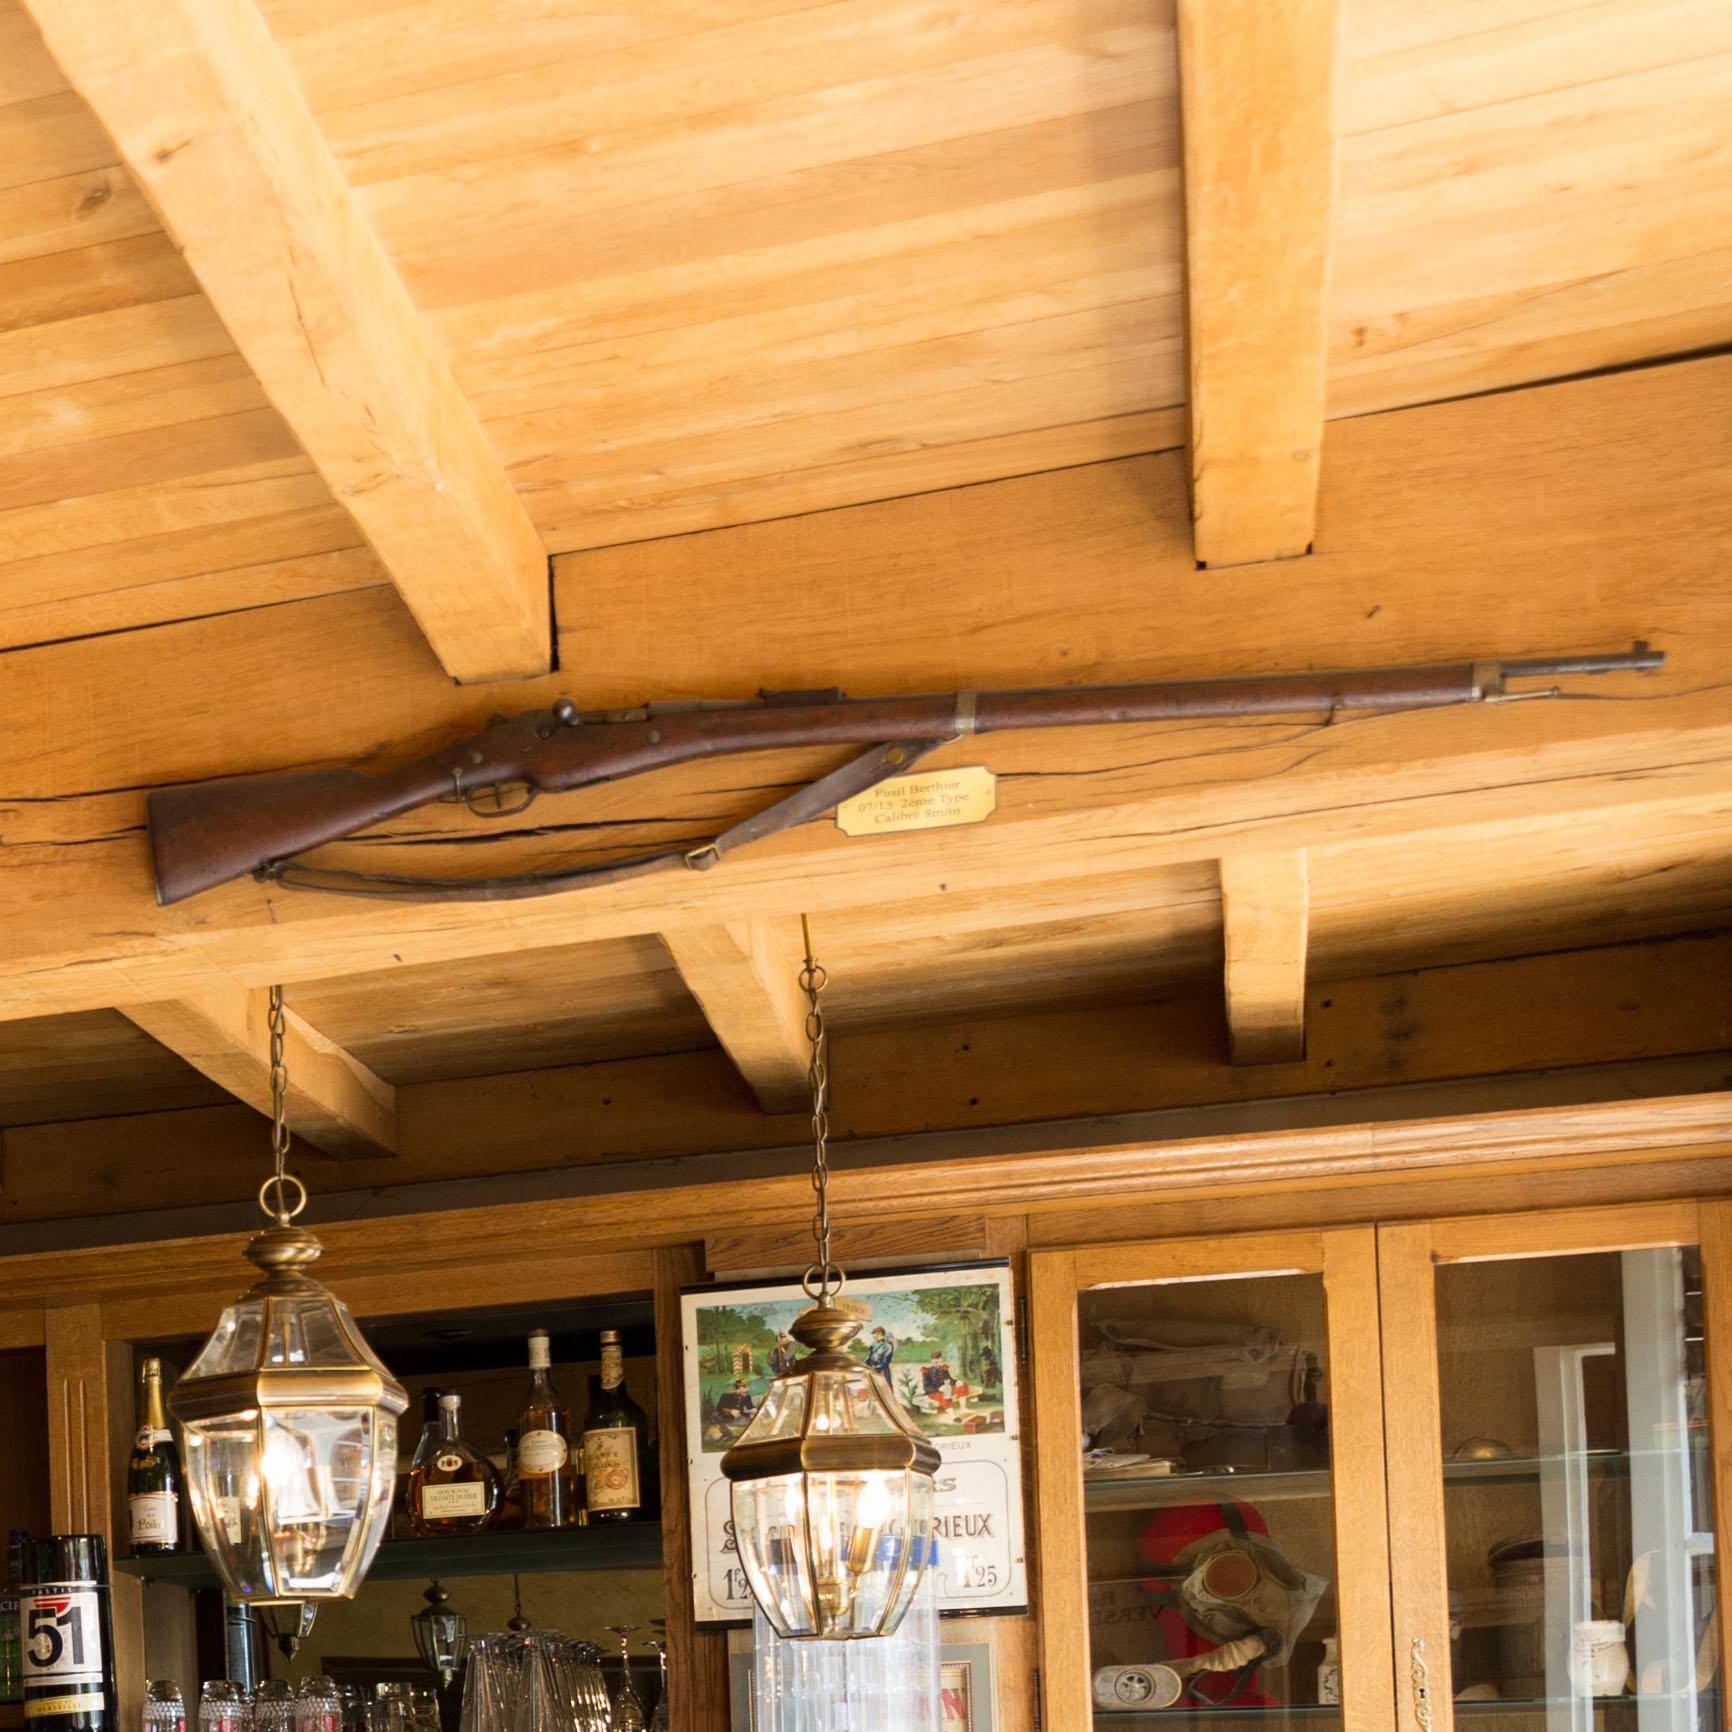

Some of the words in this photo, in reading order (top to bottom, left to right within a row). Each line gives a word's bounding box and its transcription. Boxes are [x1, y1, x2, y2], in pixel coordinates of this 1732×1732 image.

[874, 788, 905, 799] Fusil
[910, 780, 960, 794] Berthier
[858, 802, 893, 814] 07/15
[941, 793, 969, 805] Type
[874, 811, 920, 825] Calibre
[28, 1606, 84, 1668] 51
